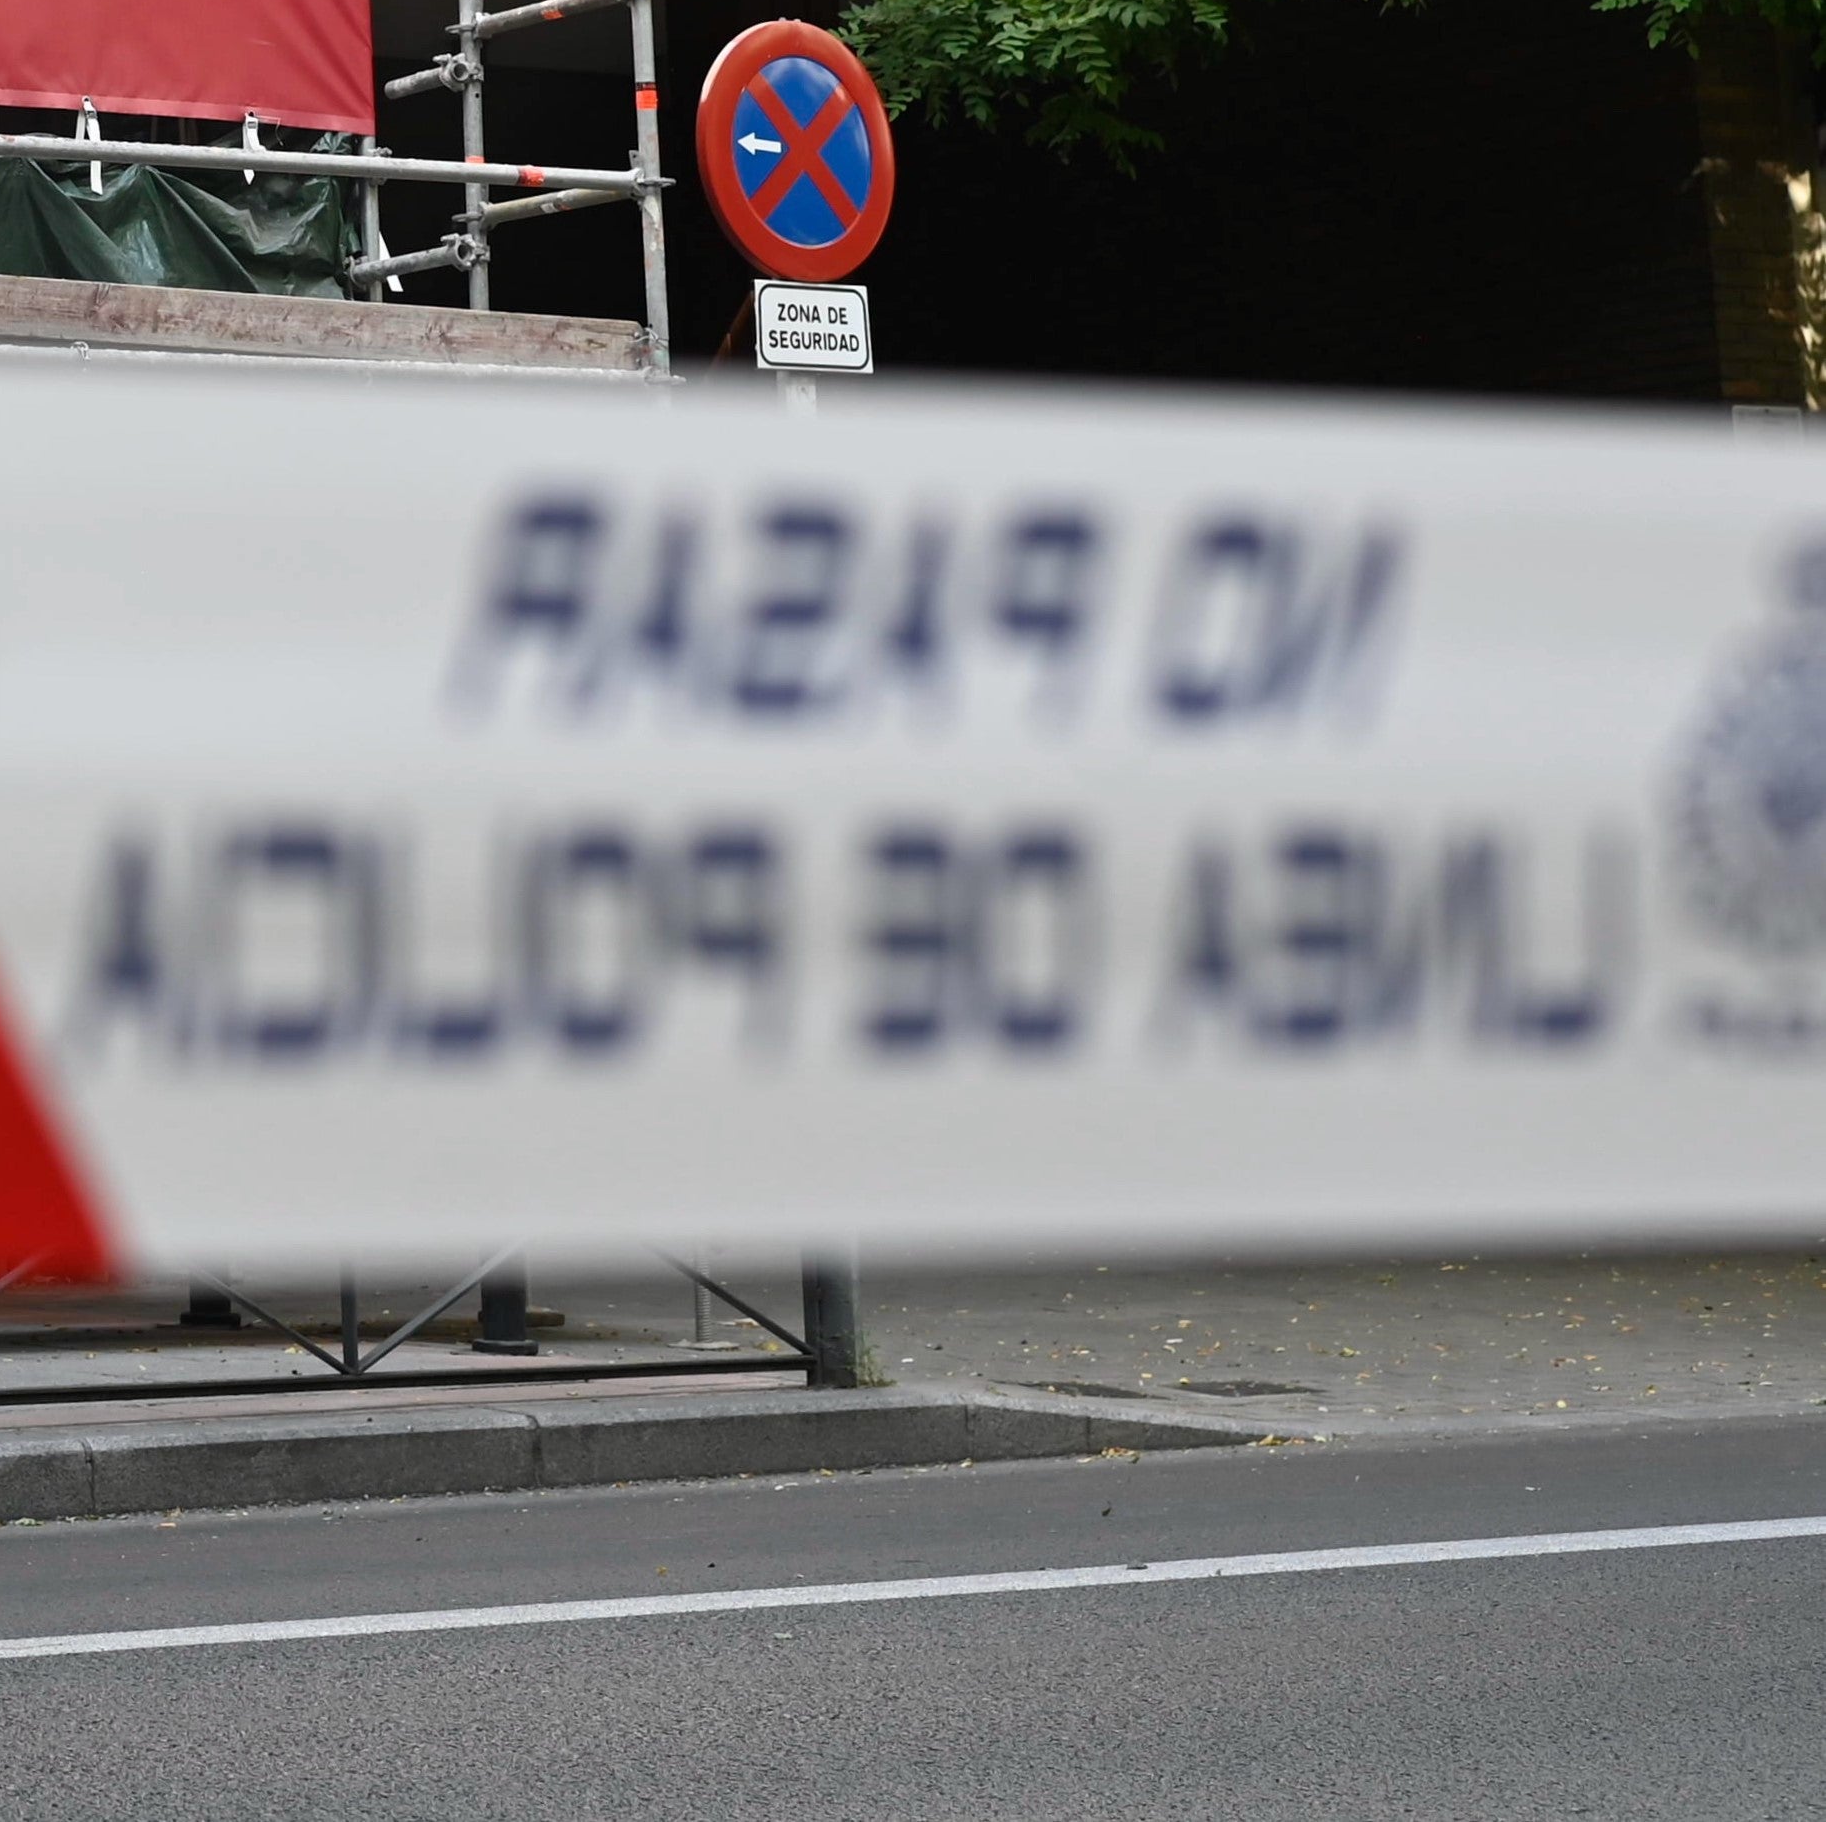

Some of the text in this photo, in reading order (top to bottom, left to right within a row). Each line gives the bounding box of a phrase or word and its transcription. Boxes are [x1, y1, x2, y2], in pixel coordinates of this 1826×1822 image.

[777, 303, 849, 325] ZONA DE
[768, 330, 860, 353] SEGURIDAD
